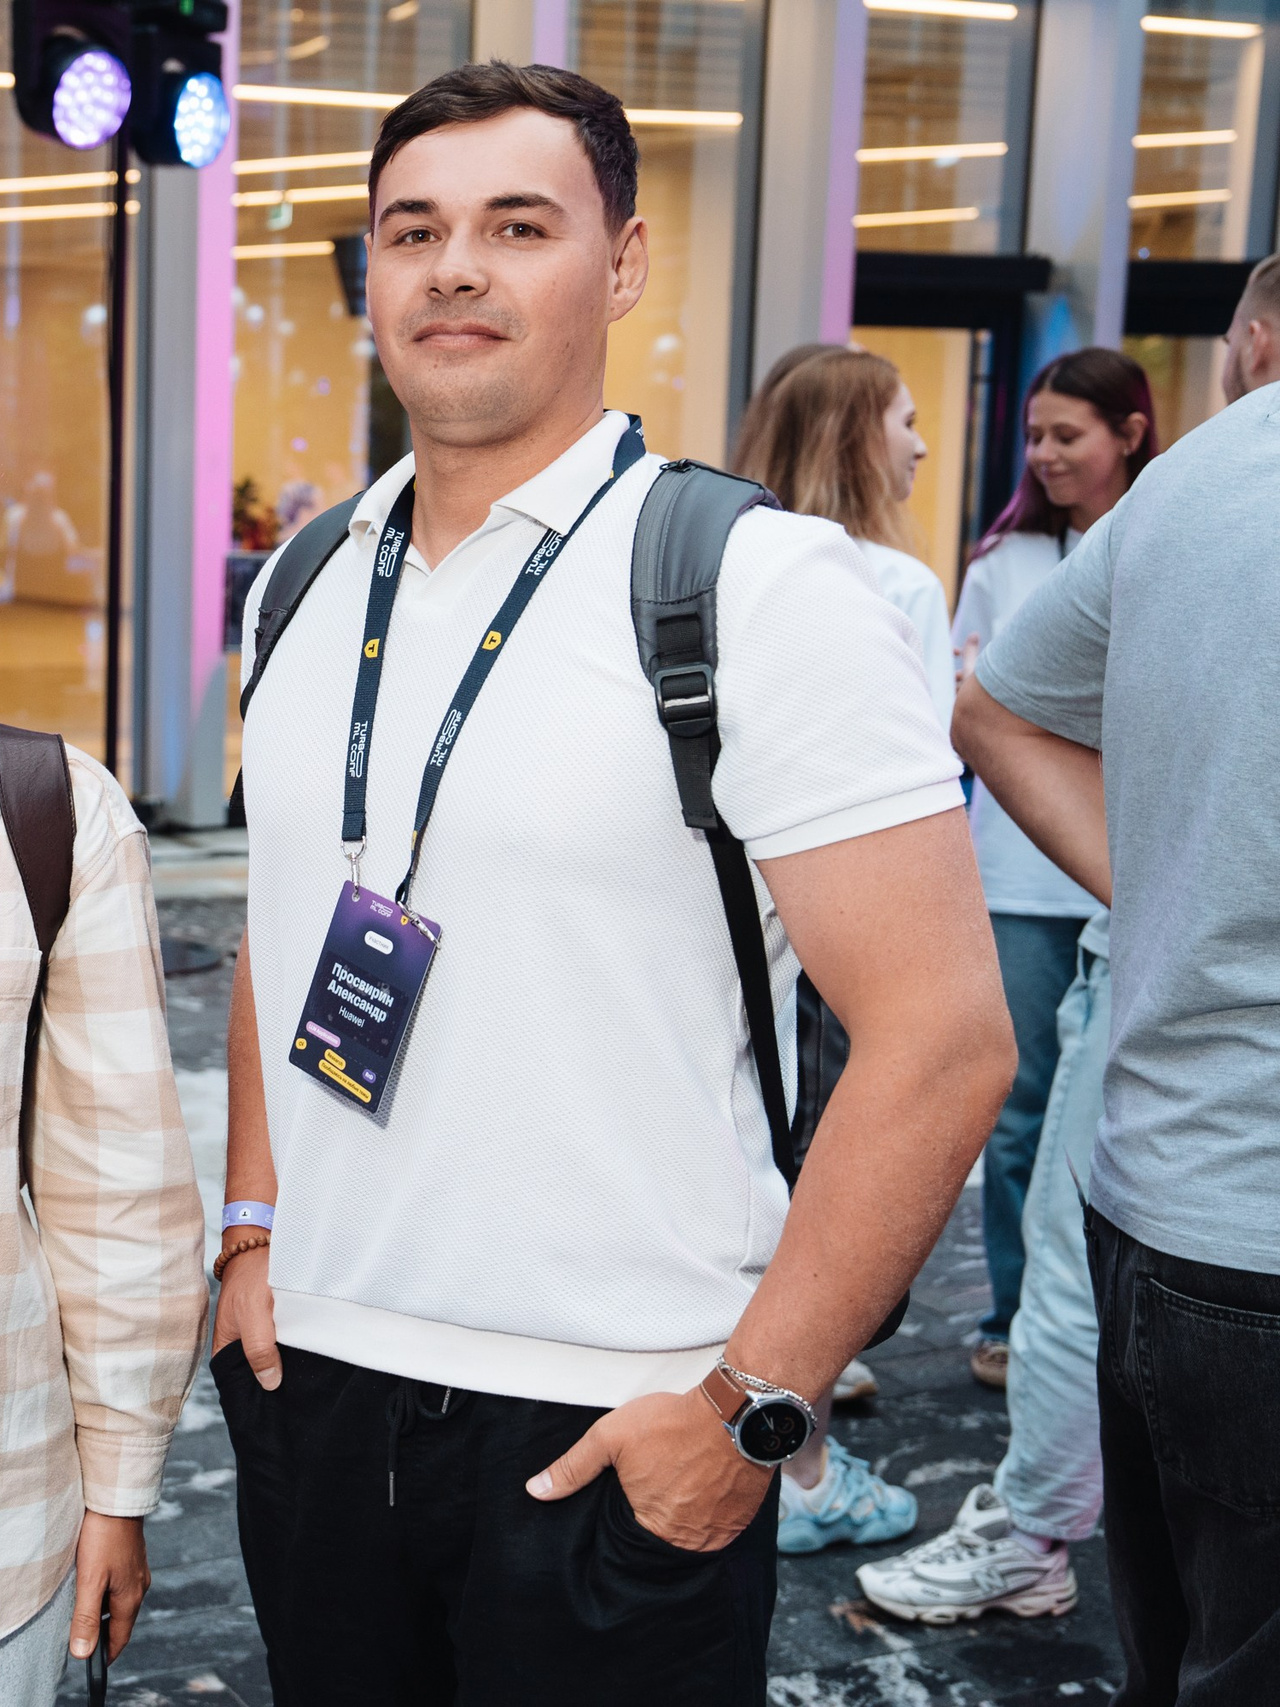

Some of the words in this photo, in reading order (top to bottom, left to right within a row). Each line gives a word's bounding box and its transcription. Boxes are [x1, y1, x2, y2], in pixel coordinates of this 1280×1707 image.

[385, 532, 404, 577] TURBO
[548, 534, 563, 556] CON
[356, 721, 368, 778] TURBO
[430, 709, 457, 765] TURBO
[327, 980, 387, 1023] Александр
[331, 963, 394, 1007] Просвирин
[339, 1005, 365, 1028] Huawei
